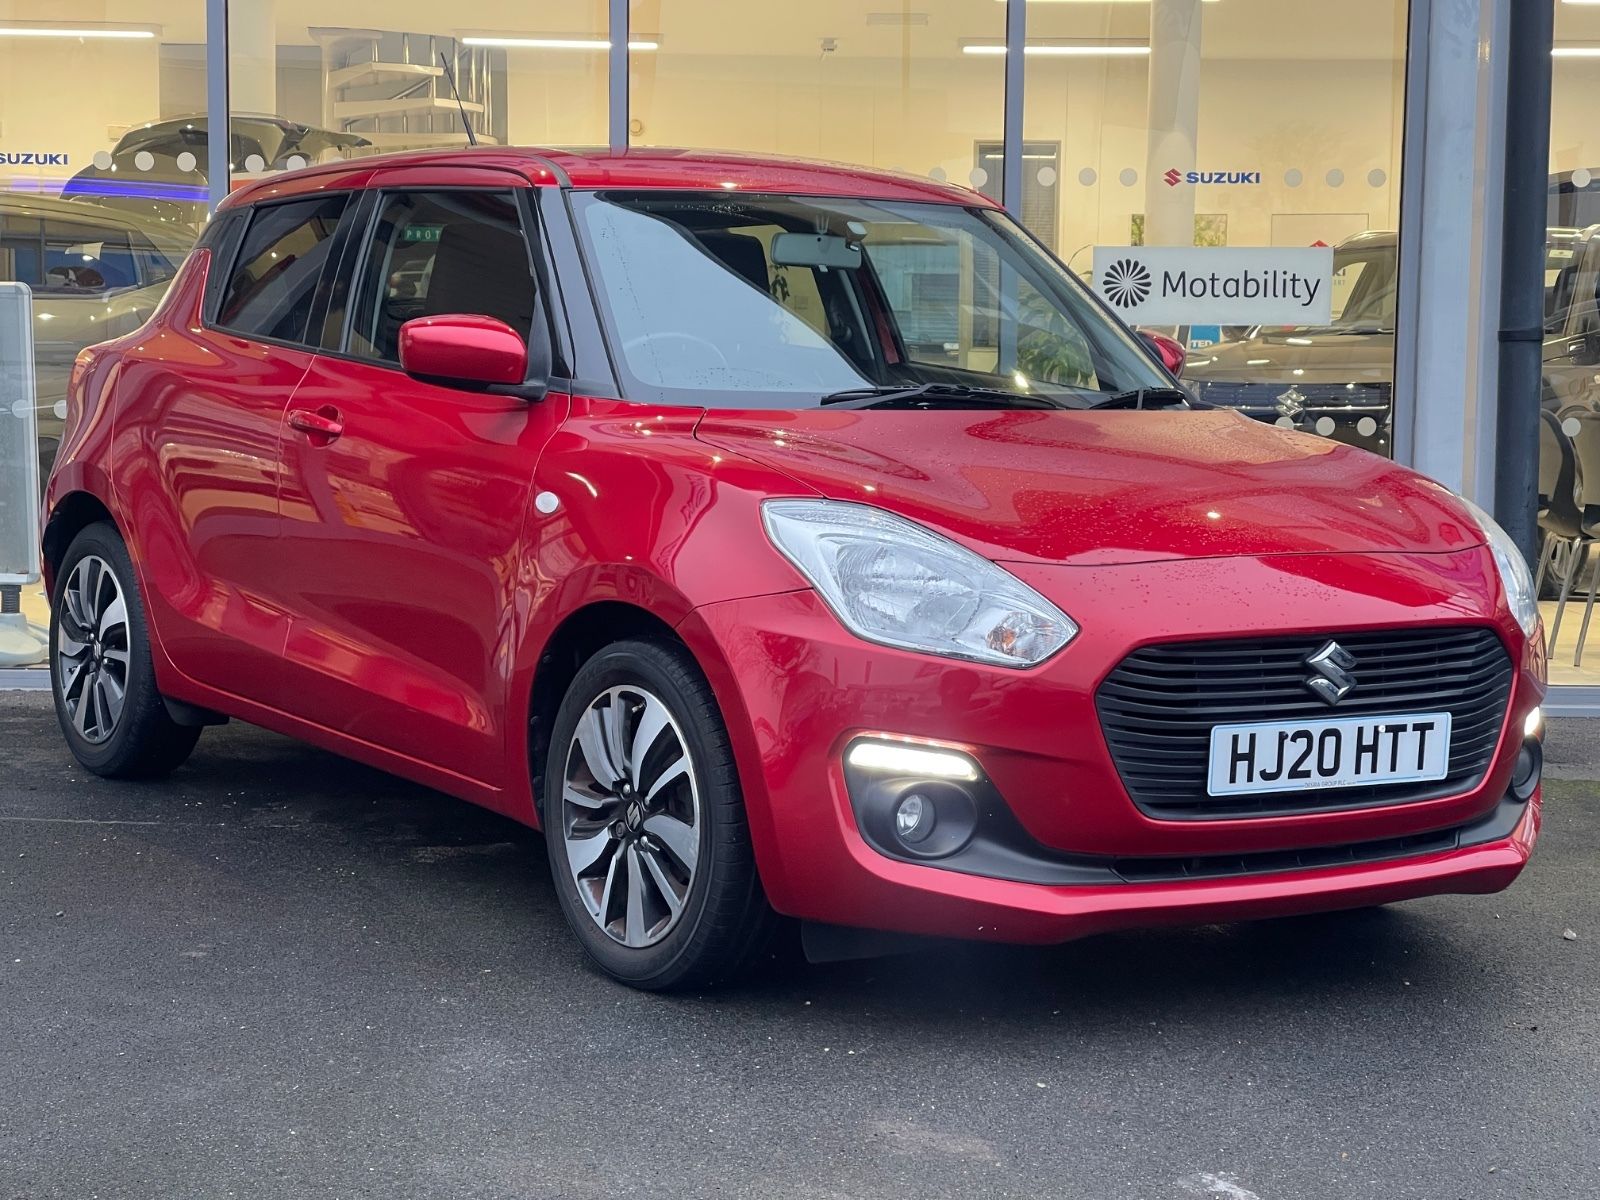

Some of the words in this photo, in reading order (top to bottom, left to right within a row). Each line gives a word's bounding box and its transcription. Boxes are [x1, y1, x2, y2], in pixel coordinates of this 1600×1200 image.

[1186, 172, 1260, 184] SUZUKI
[1162, 270, 1321, 307] Motability
[1229, 728, 1342, 784] HJ20
[1354, 722, 1435, 775] HTT
